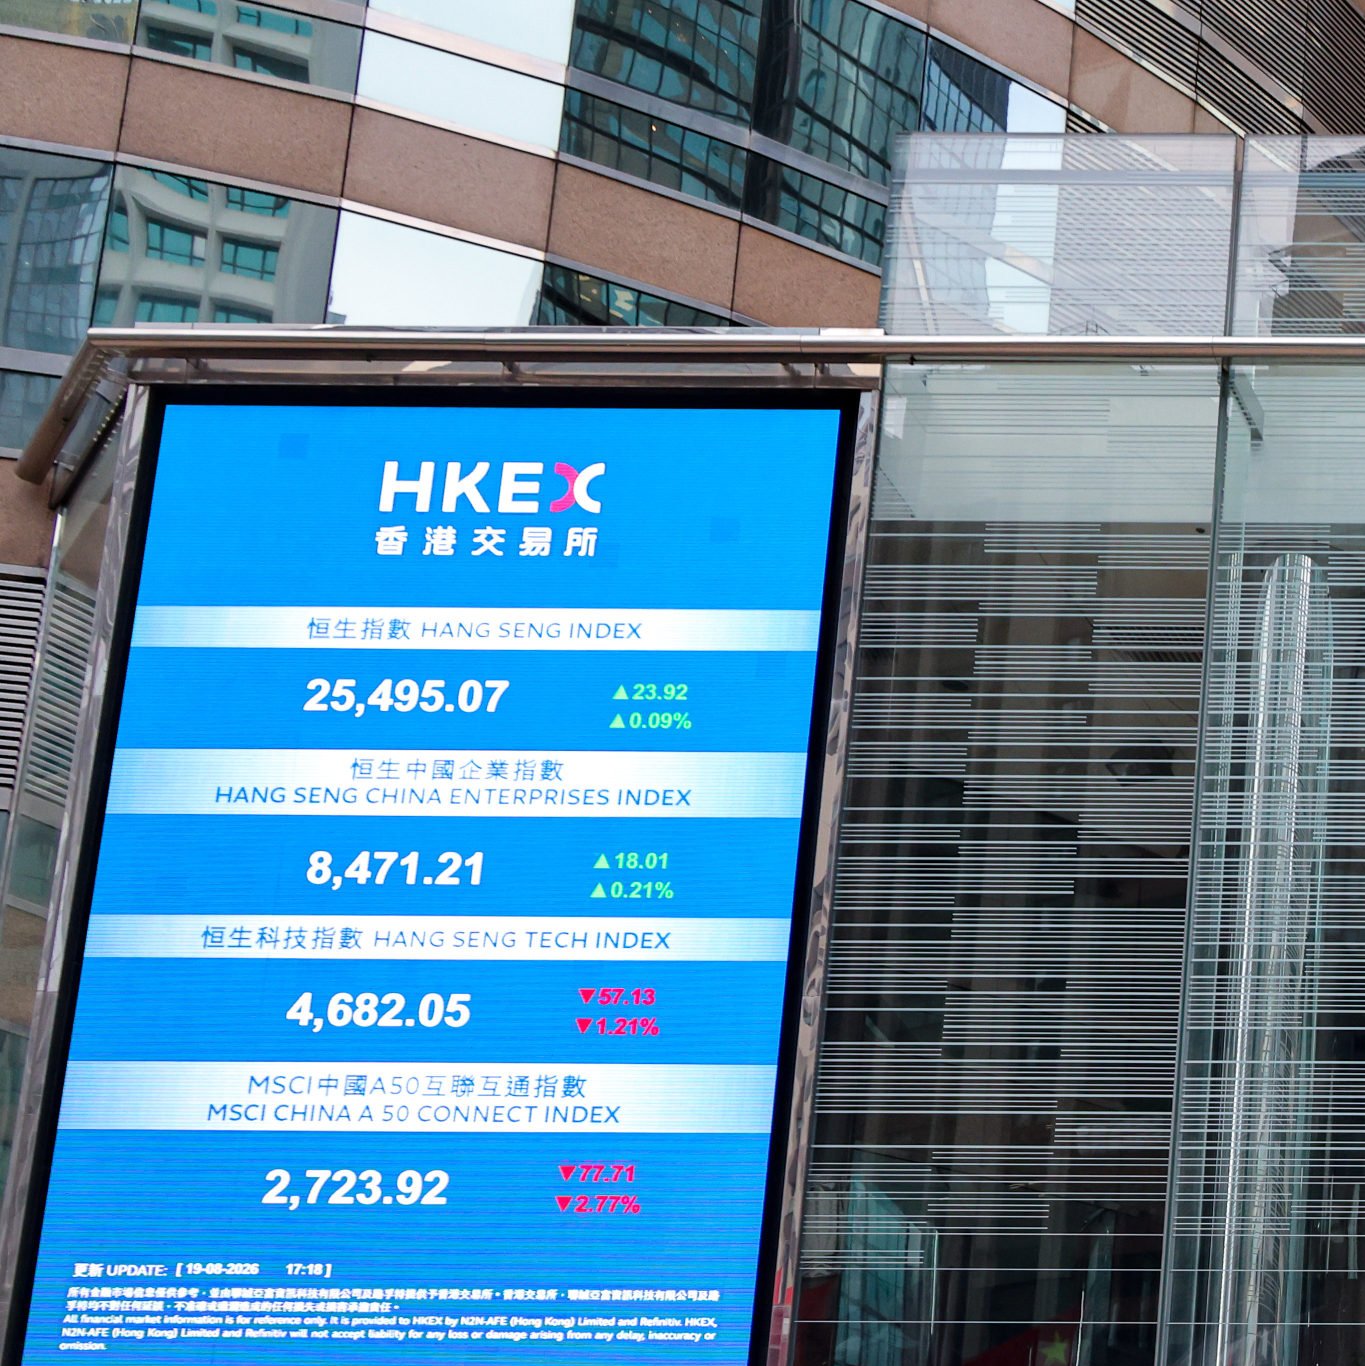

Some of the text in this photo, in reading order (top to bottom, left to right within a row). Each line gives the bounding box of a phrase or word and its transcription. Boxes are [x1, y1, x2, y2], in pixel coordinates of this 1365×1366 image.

[380, 461, 605, 513] HKEX
[376, 526, 597, 556] 香港交易所
[308, 618, 640, 639] 恒生指數 HANG SENG INDEX
[304, 679, 509, 717] 25,495.07
[633, 684, 687, 700] 23.92
[630, 713, 691, 728] 0.09%
[352, 759, 563, 780] 恒生中國企業指數
[215, 786, 691, 806] HANG SENG CHINA ENTERPRISES INDEX
[307, 851, 482, 890] 8,471.21
[616, 853, 667, 869] 18.01
[611, 882, 673, 898] 0.21%
[201, 926, 671, 949] 恒生科技指數 HANG SENG TECH INDEX
[599, 988, 655, 1004] 57.13
[287, 993, 470, 1032] 4,682.05
[597, 1018, 659, 1035] 1.21%
[208, 1104, 620, 1123] MSCI CHINA A 50 CONNECT INDEX
[580, 1165, 634, 1182] 77.71
[262, 1170, 448, 1210] 2,723.92
[575, 1195, 640, 1213] 2.77%
[107, 1265, 167, 1276] UPDATE:
[187, 1263, 259, 1274] 19-08-2026
[287, 1264, 322, 1275] 17:18
